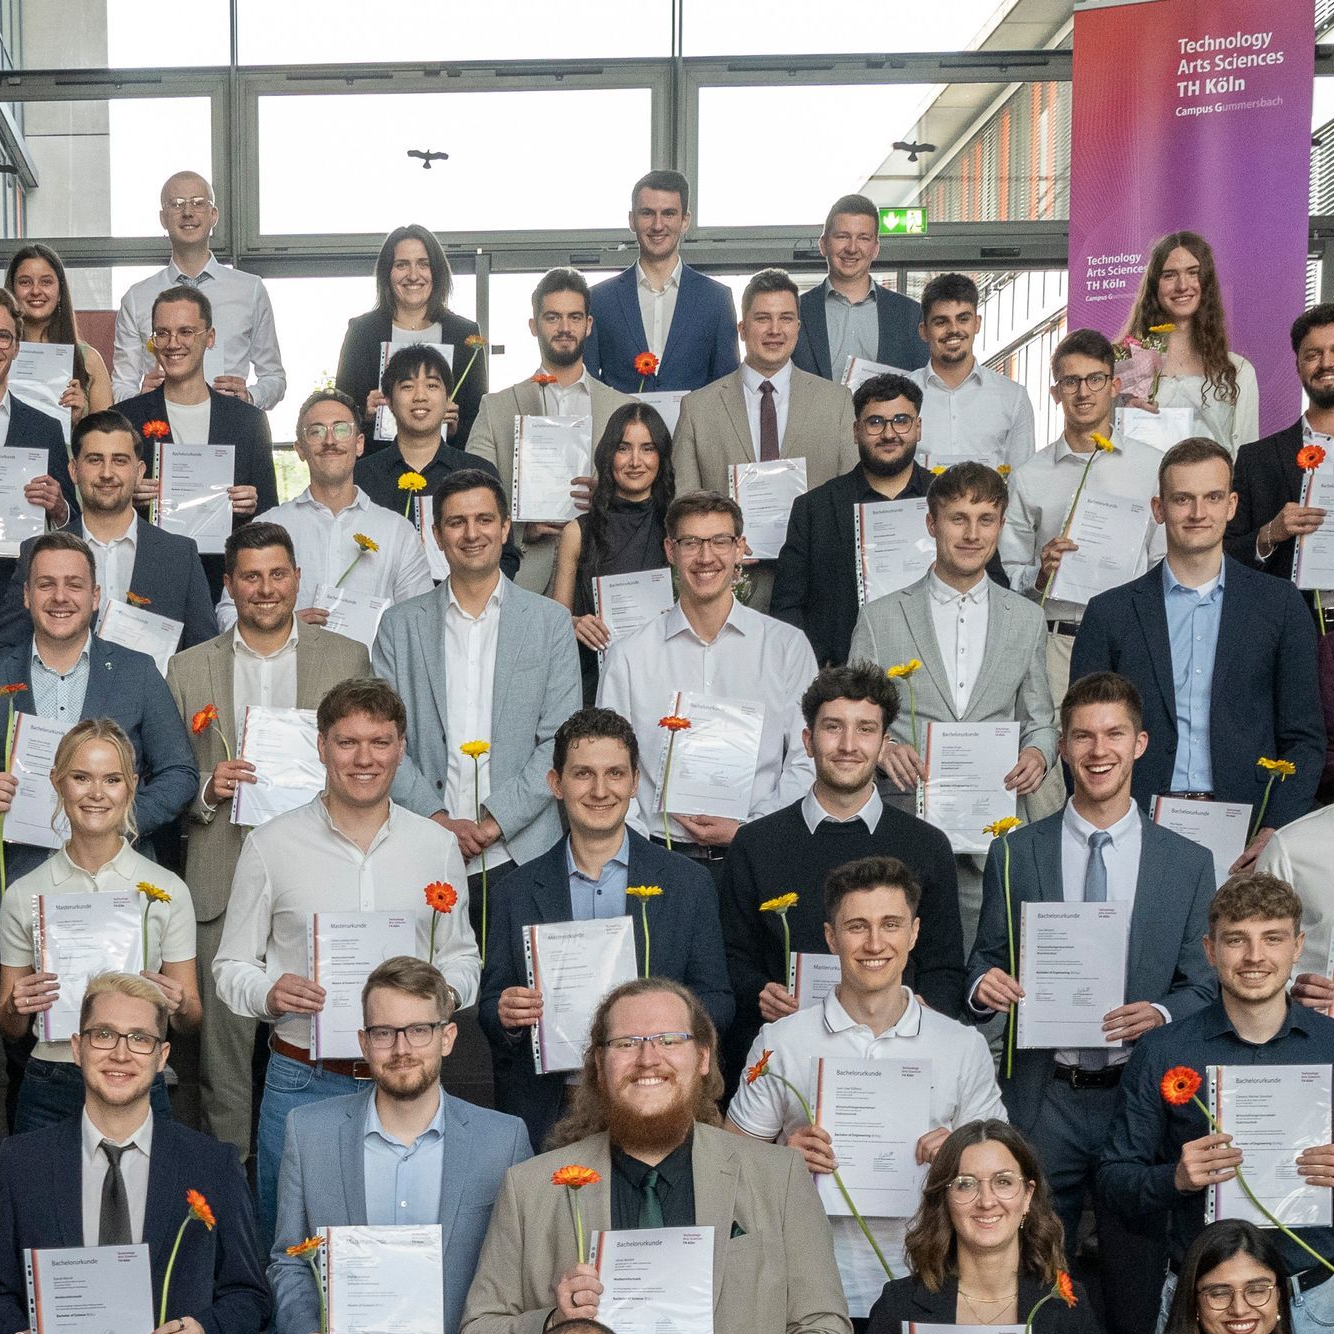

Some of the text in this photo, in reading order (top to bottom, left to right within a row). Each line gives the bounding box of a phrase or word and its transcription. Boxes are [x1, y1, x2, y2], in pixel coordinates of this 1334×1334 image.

[1178, 32, 1272, 54] Technology
[1178, 51, 1284, 75] Arts Sciences
[1177, 76, 1245, 97] TH Köln
[1176, 97, 1282, 116] Campus Gummersbach
[1087, 253, 1141, 265] Technology
[1087, 268, 1106, 278] Arts
[1087, 278, 1126, 291] TH Köln
[1086, 294, 1107, 302] Campus
[836, 1069, 882, 1078] Bachelorurkunde
[1236, 1077, 1281, 1085] Bachelorurkunde
[617, 1239, 663, 1249] Bachelorurkunde
[52, 1257, 99, 1267] Bachelorurkunde
